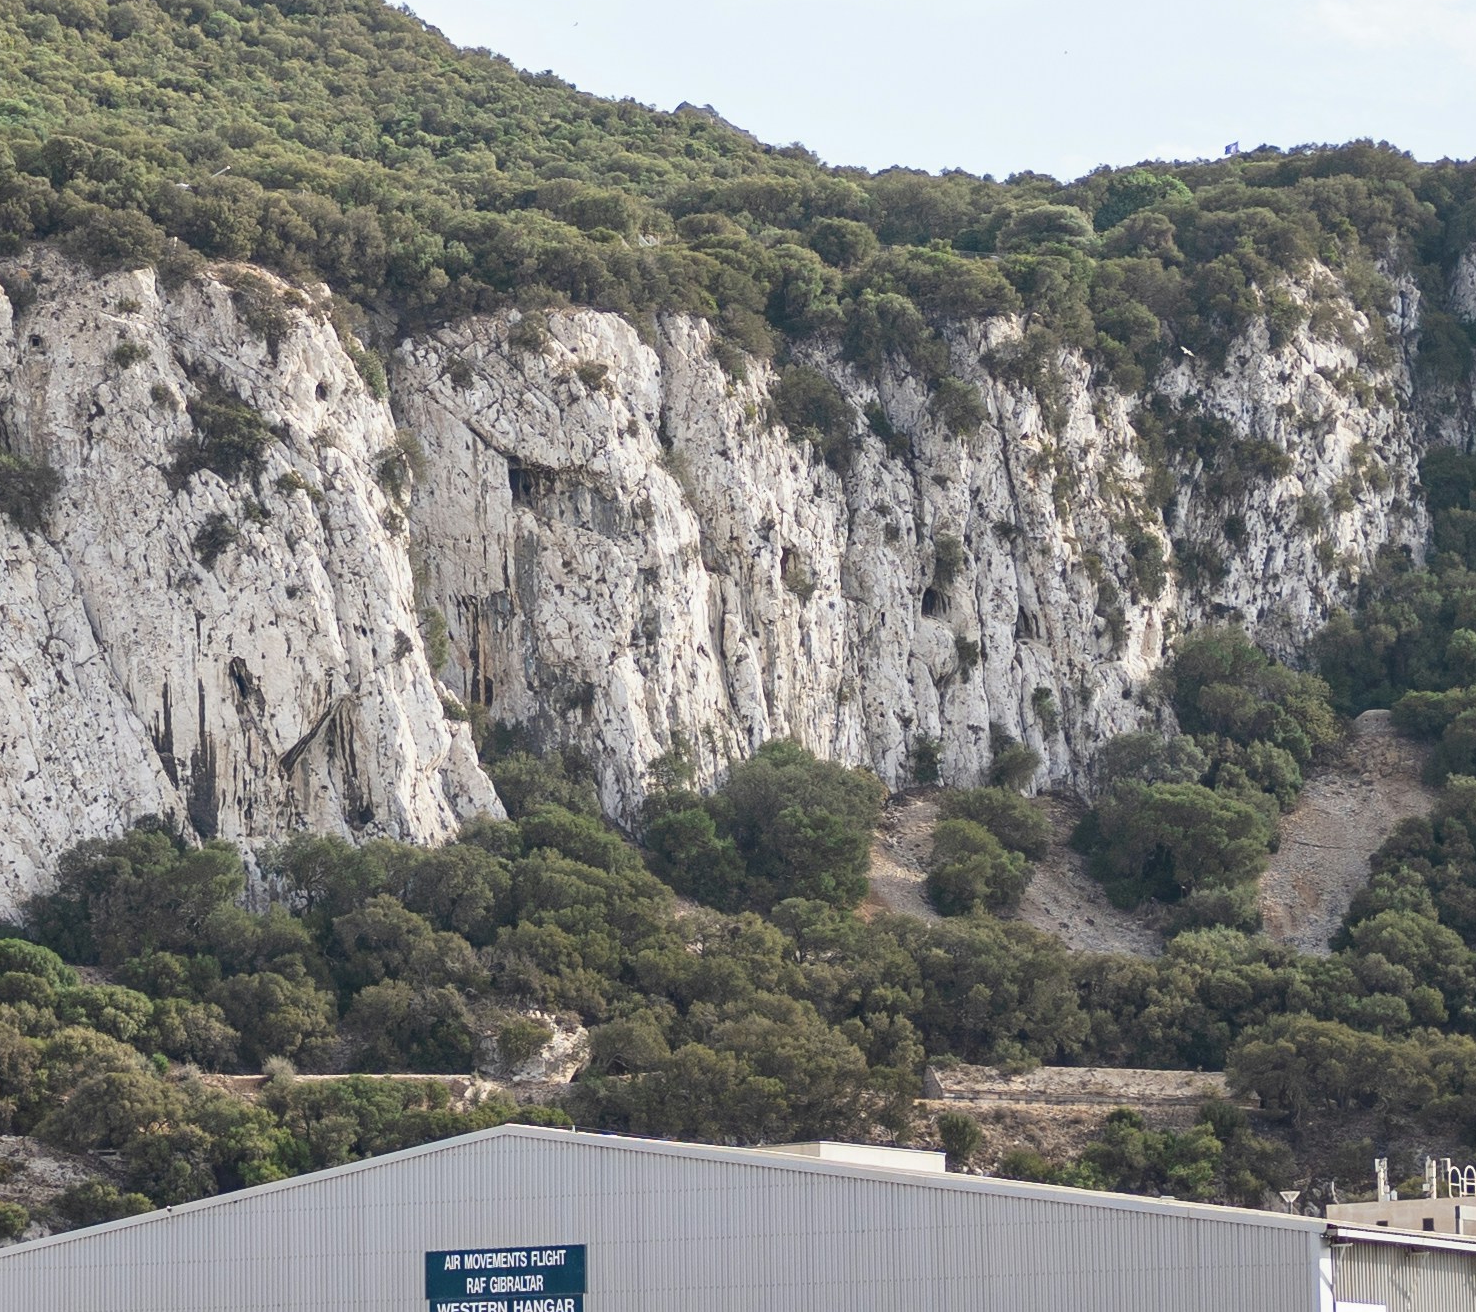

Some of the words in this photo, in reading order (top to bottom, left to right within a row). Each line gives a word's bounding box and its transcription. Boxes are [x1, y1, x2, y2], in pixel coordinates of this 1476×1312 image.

[444, 1254, 461, 1270] AIR
[464, 1251, 528, 1269] MOVEMENTS
[531, 1249, 567, 1267] FLIGHT
[466, 1276, 487, 1294] RAF
[489, 1274, 544, 1293] GIBRALTAR
